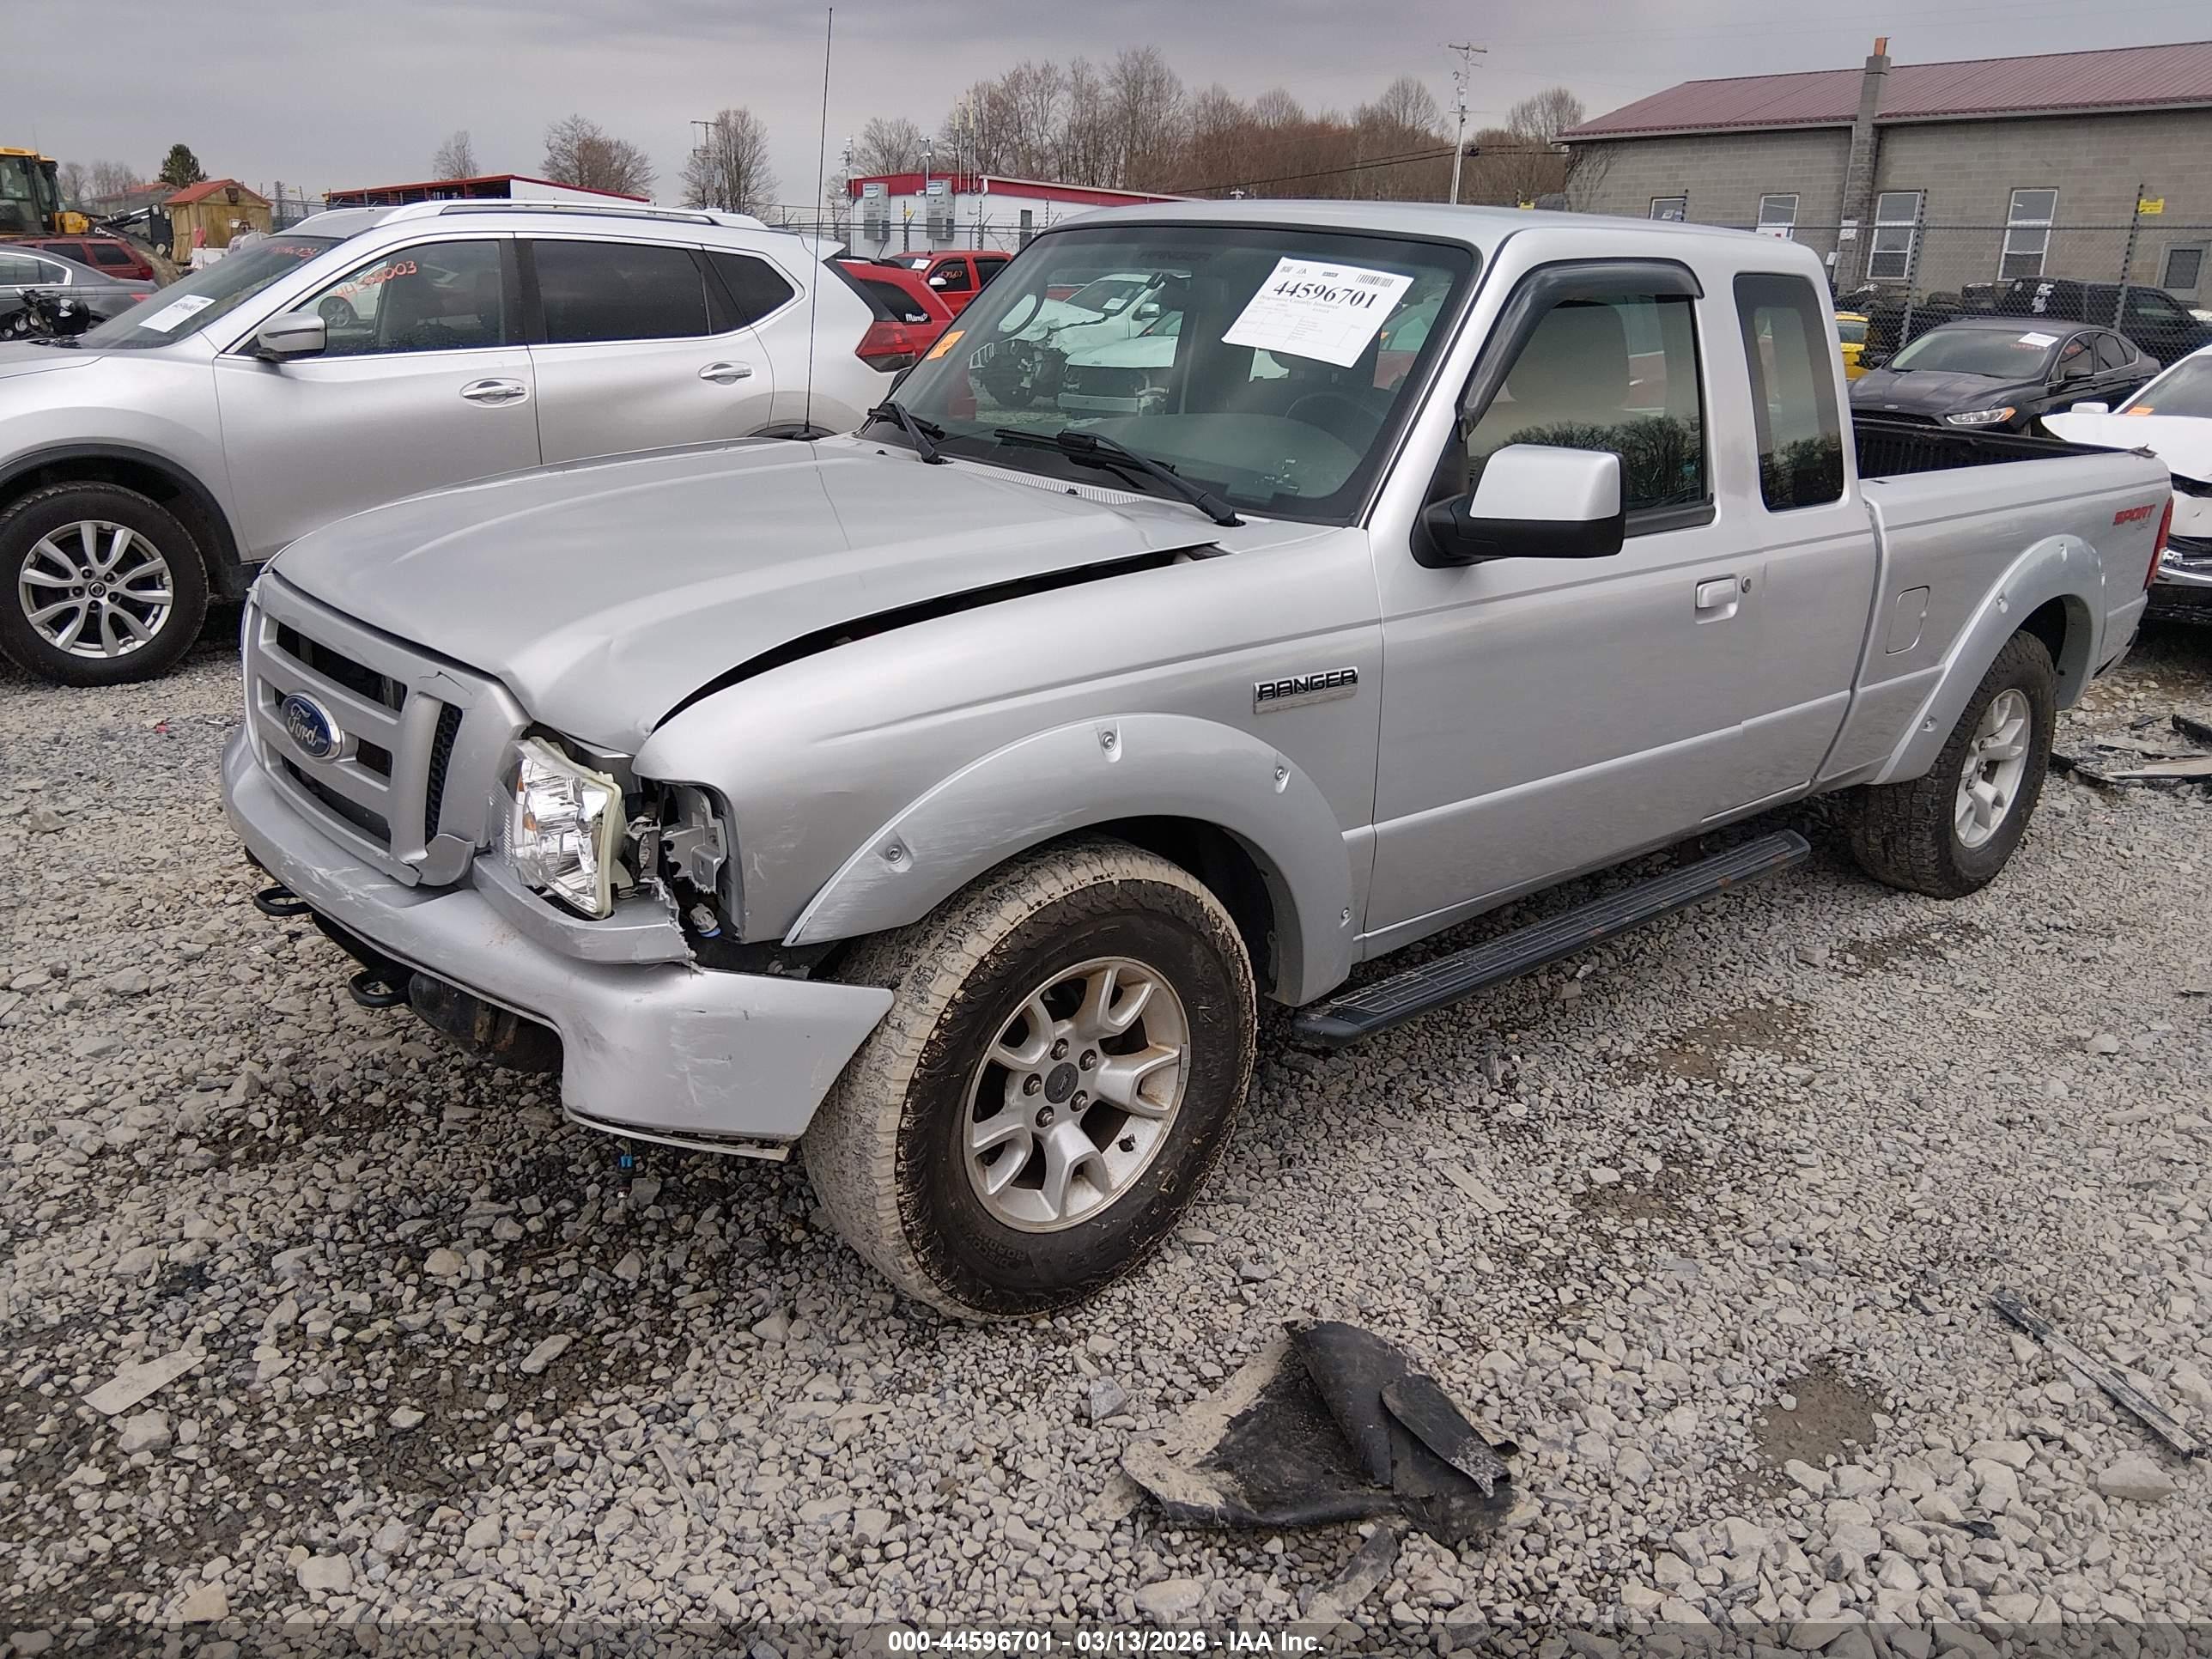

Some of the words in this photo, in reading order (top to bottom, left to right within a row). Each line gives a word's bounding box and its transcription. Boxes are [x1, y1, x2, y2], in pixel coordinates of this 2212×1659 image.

[1273, 280, 1379, 310] 44596701
[2112, 504, 2156, 526] SPORT
[1257, 669, 1358, 701] RANGER
[287, 702, 319, 747] Ford
